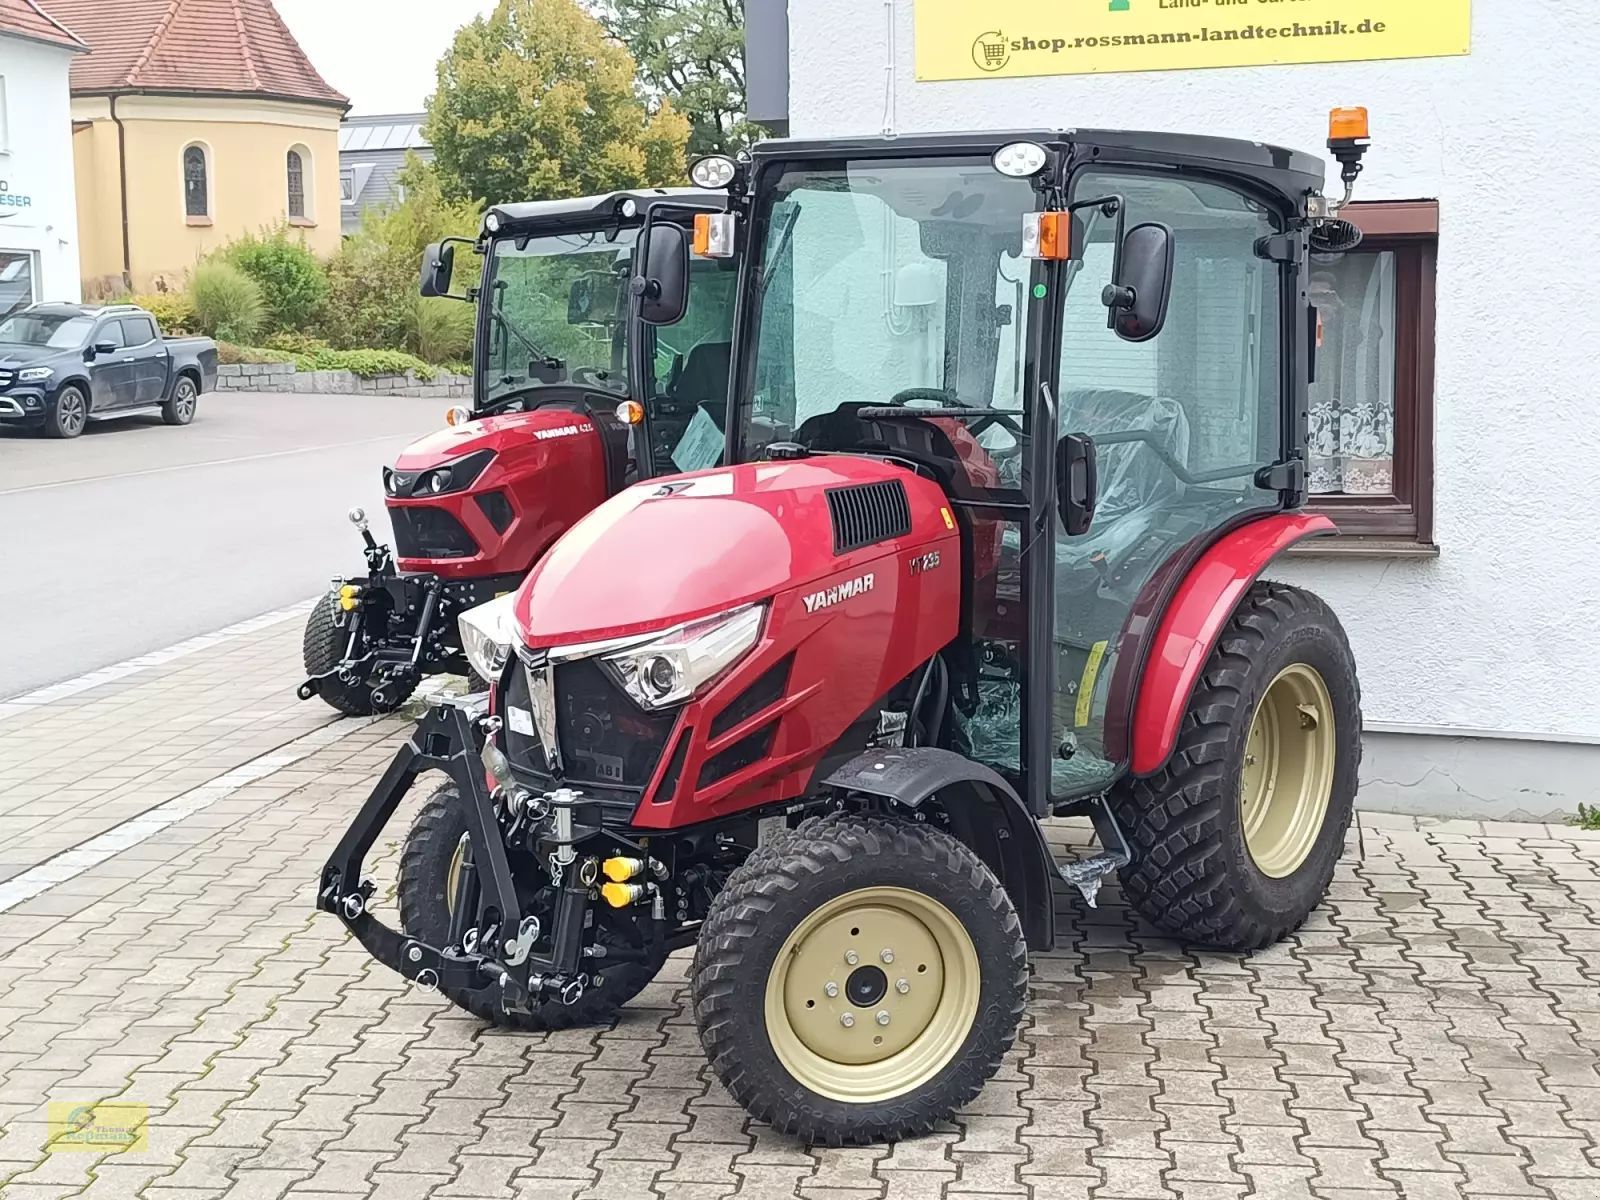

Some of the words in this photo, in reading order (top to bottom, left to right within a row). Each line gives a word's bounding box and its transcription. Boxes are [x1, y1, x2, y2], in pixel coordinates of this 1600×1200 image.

[1010, 18, 1387, 53] shop.rossmann-landtechnik.de
[533, 426, 578, 440] YANMAR
[908, 550, 941, 576] YT235
[802, 573, 875, 614] YANMAR
